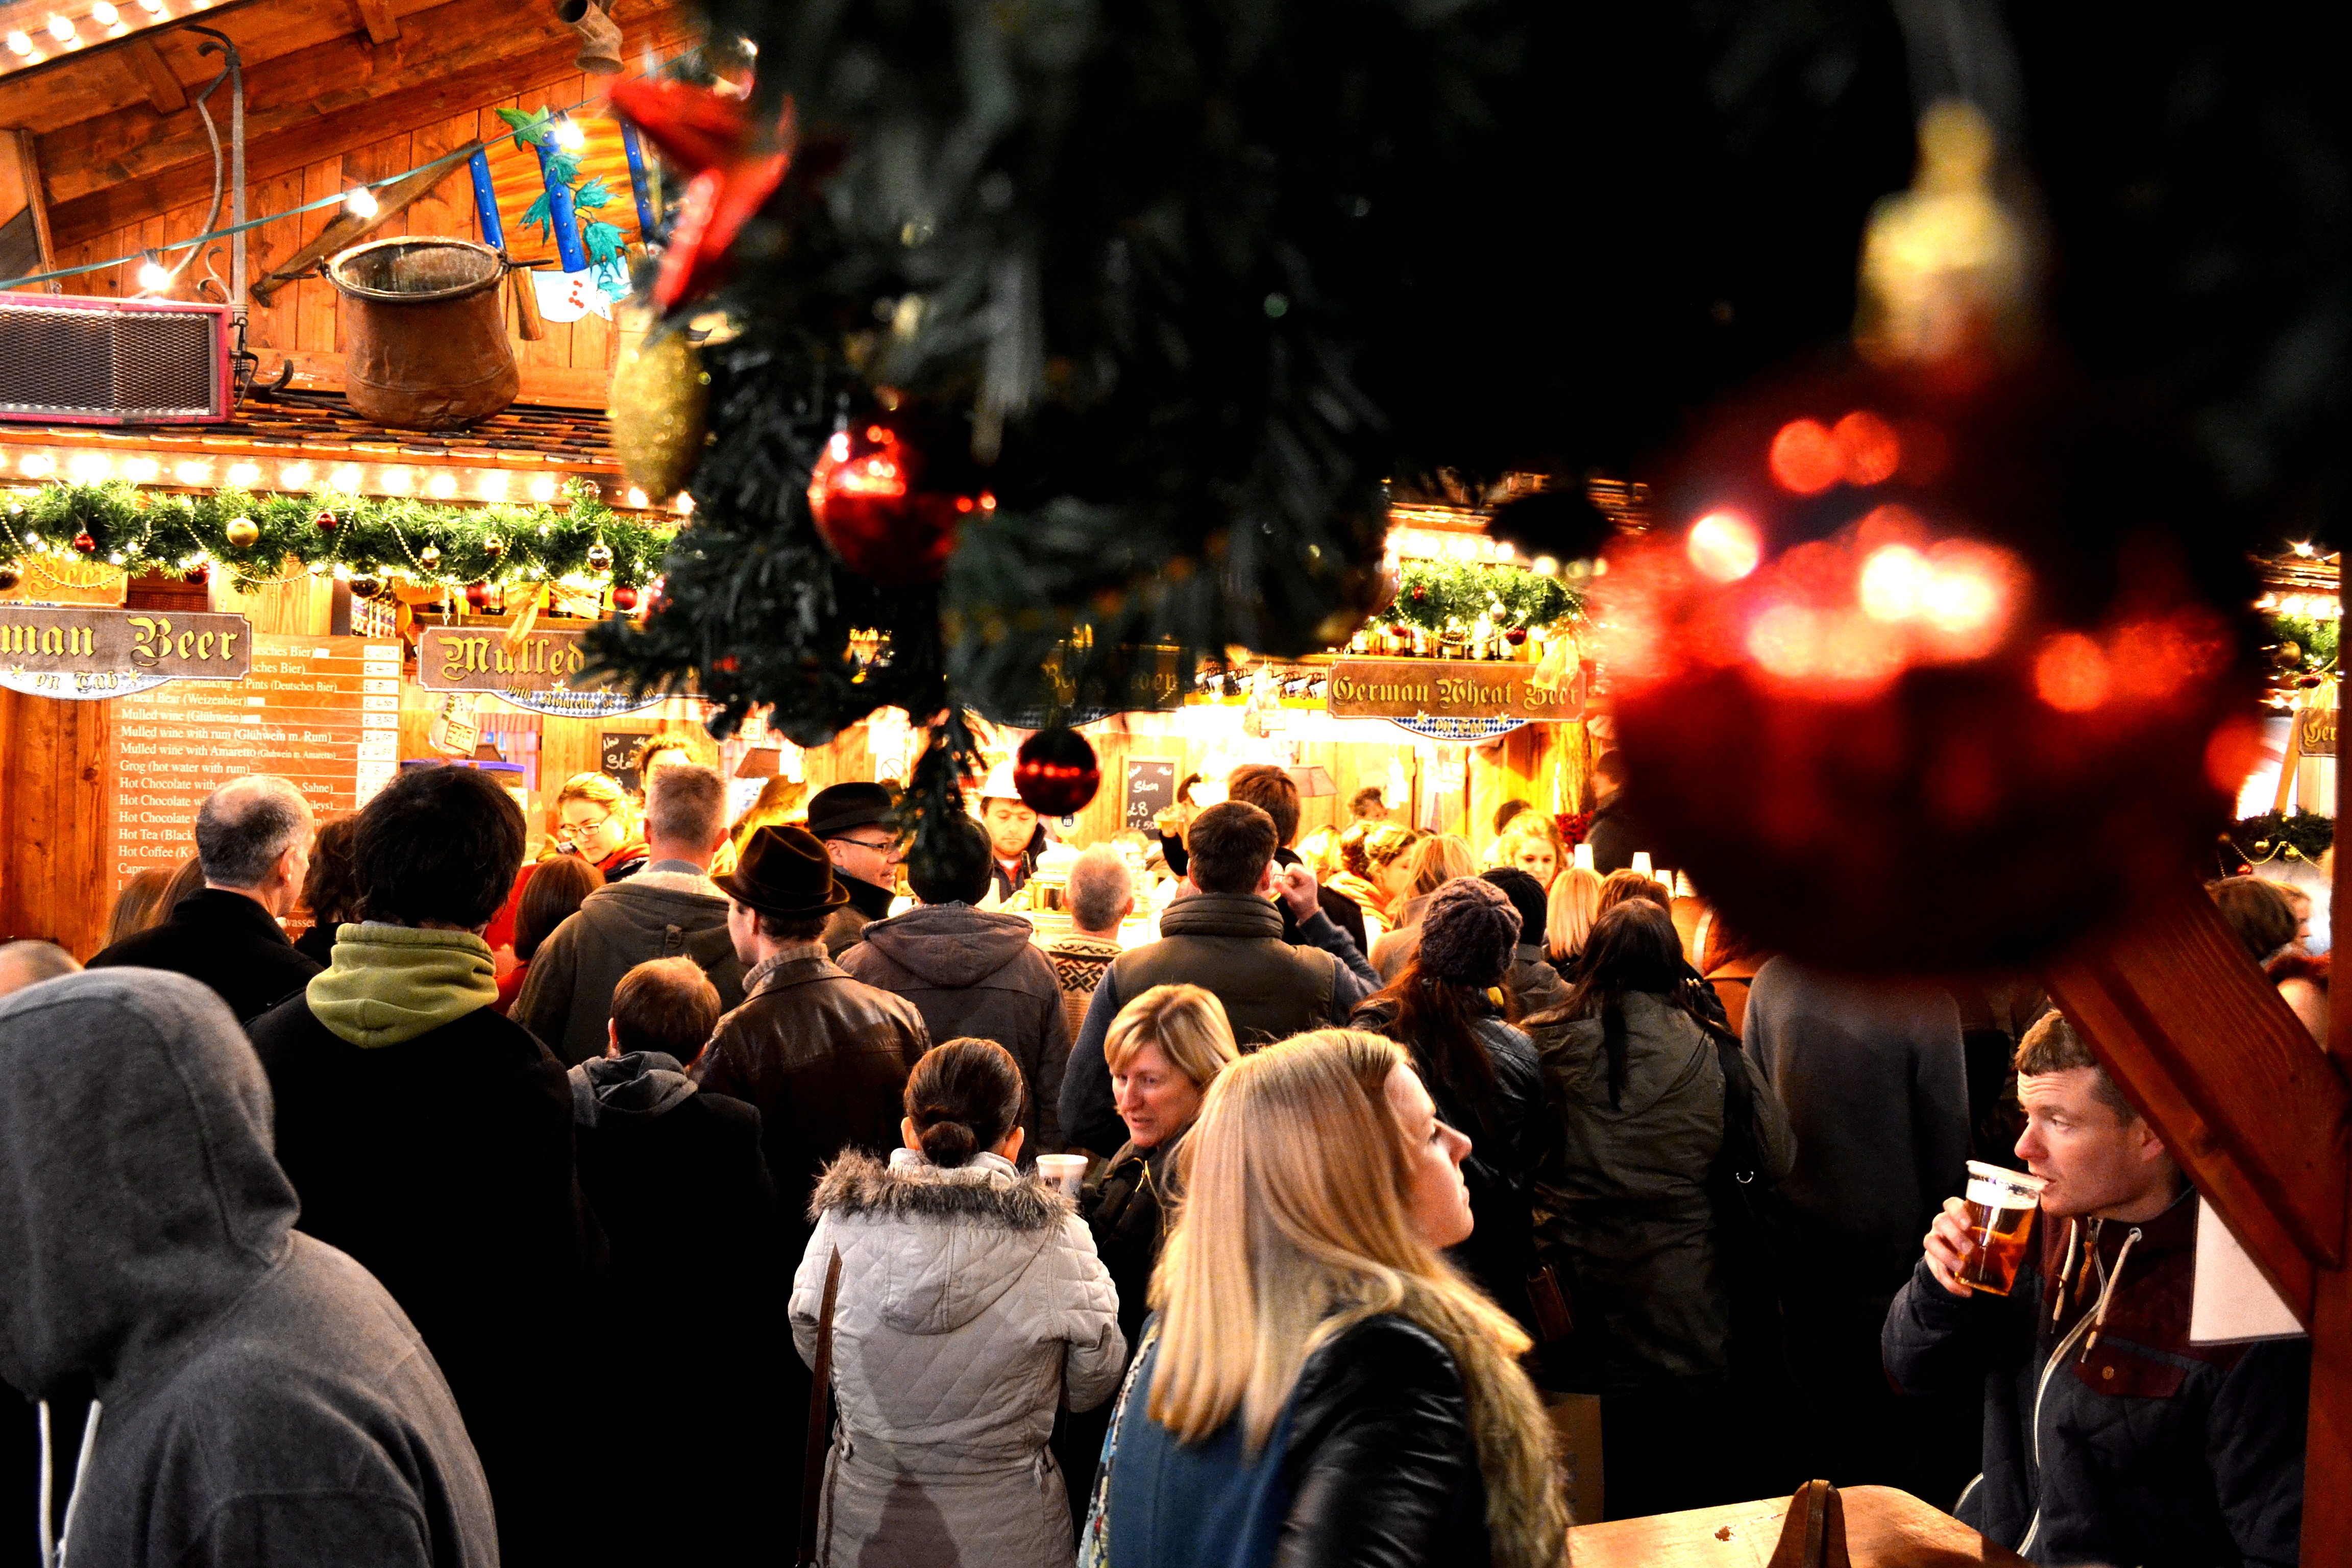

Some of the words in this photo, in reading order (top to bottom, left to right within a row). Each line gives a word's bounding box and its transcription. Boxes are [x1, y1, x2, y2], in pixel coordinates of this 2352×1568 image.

[127, 616, 239, 667] Beer
[290, 645, 315, 659] Bier)
[438, 635, 585, 681] Mulled
[280, 662, 306, 676] Bier)
[35, 672, 60, 690] on
[75, 670, 119, 693] Tab
[246, 678, 268, 690] Pints
[271, 679, 314, 692] (Deutsches
[316, 681, 337, 693] Bier)
[183, 693, 247, 706] (Weizenbier)
[506, 684, 531, 701] with
[540, 692, 595, 708] Amaretto
[1332, 675, 1429, 705] German
[1436, 678, 1512, 708] Wheat
[1522, 678, 1578, 710] Beer
[121, 708, 158, 720] Mulled
[160, 709, 184, 721] wine
[187, 710, 243, 724] (Glühwein)
[1435, 719, 1451, 732] on
[1458, 718, 1486, 733] Tab
[121, 725, 157, 738] Mulled
[160, 727, 183, 738] wine
[187, 728, 209, 739] with
[211, 730, 231, 740] rum
[234, 729, 285, 742] (Glühwein
[288, 733, 301, 742] m.
[304, 730, 332, 743] Rum)
[121, 743, 156, 754] Mulled
[159, 744, 183, 755] wine
[186, 745, 208, 756] with
[210, 745, 255, 757] Amaretto
[120, 760, 146, 774] Grog
[149, 761, 168, 773] (hot
[172, 764, 199, 773] water
[202, 762, 224, 773] with
[226, 764, 250, 776] rum)
[119, 777, 138, 788] Hot
[141, 777, 191, 790] Chocolate
[194, 779, 216, 791] with
[302, 782, 333, 795] Sahne)
[119, 794, 138, 805] Hot
[140, 794, 191, 806] Chocolate
[119, 812, 138, 822] Hot
[140, 812, 190, 824] Chocolate
[118, 828, 137, 840] Hot
[140, 829, 158, 840] Tea
[160, 829, 194, 842] (Black
[118, 846, 137, 857] Hot
[139, 846, 174, 857] Coffee
